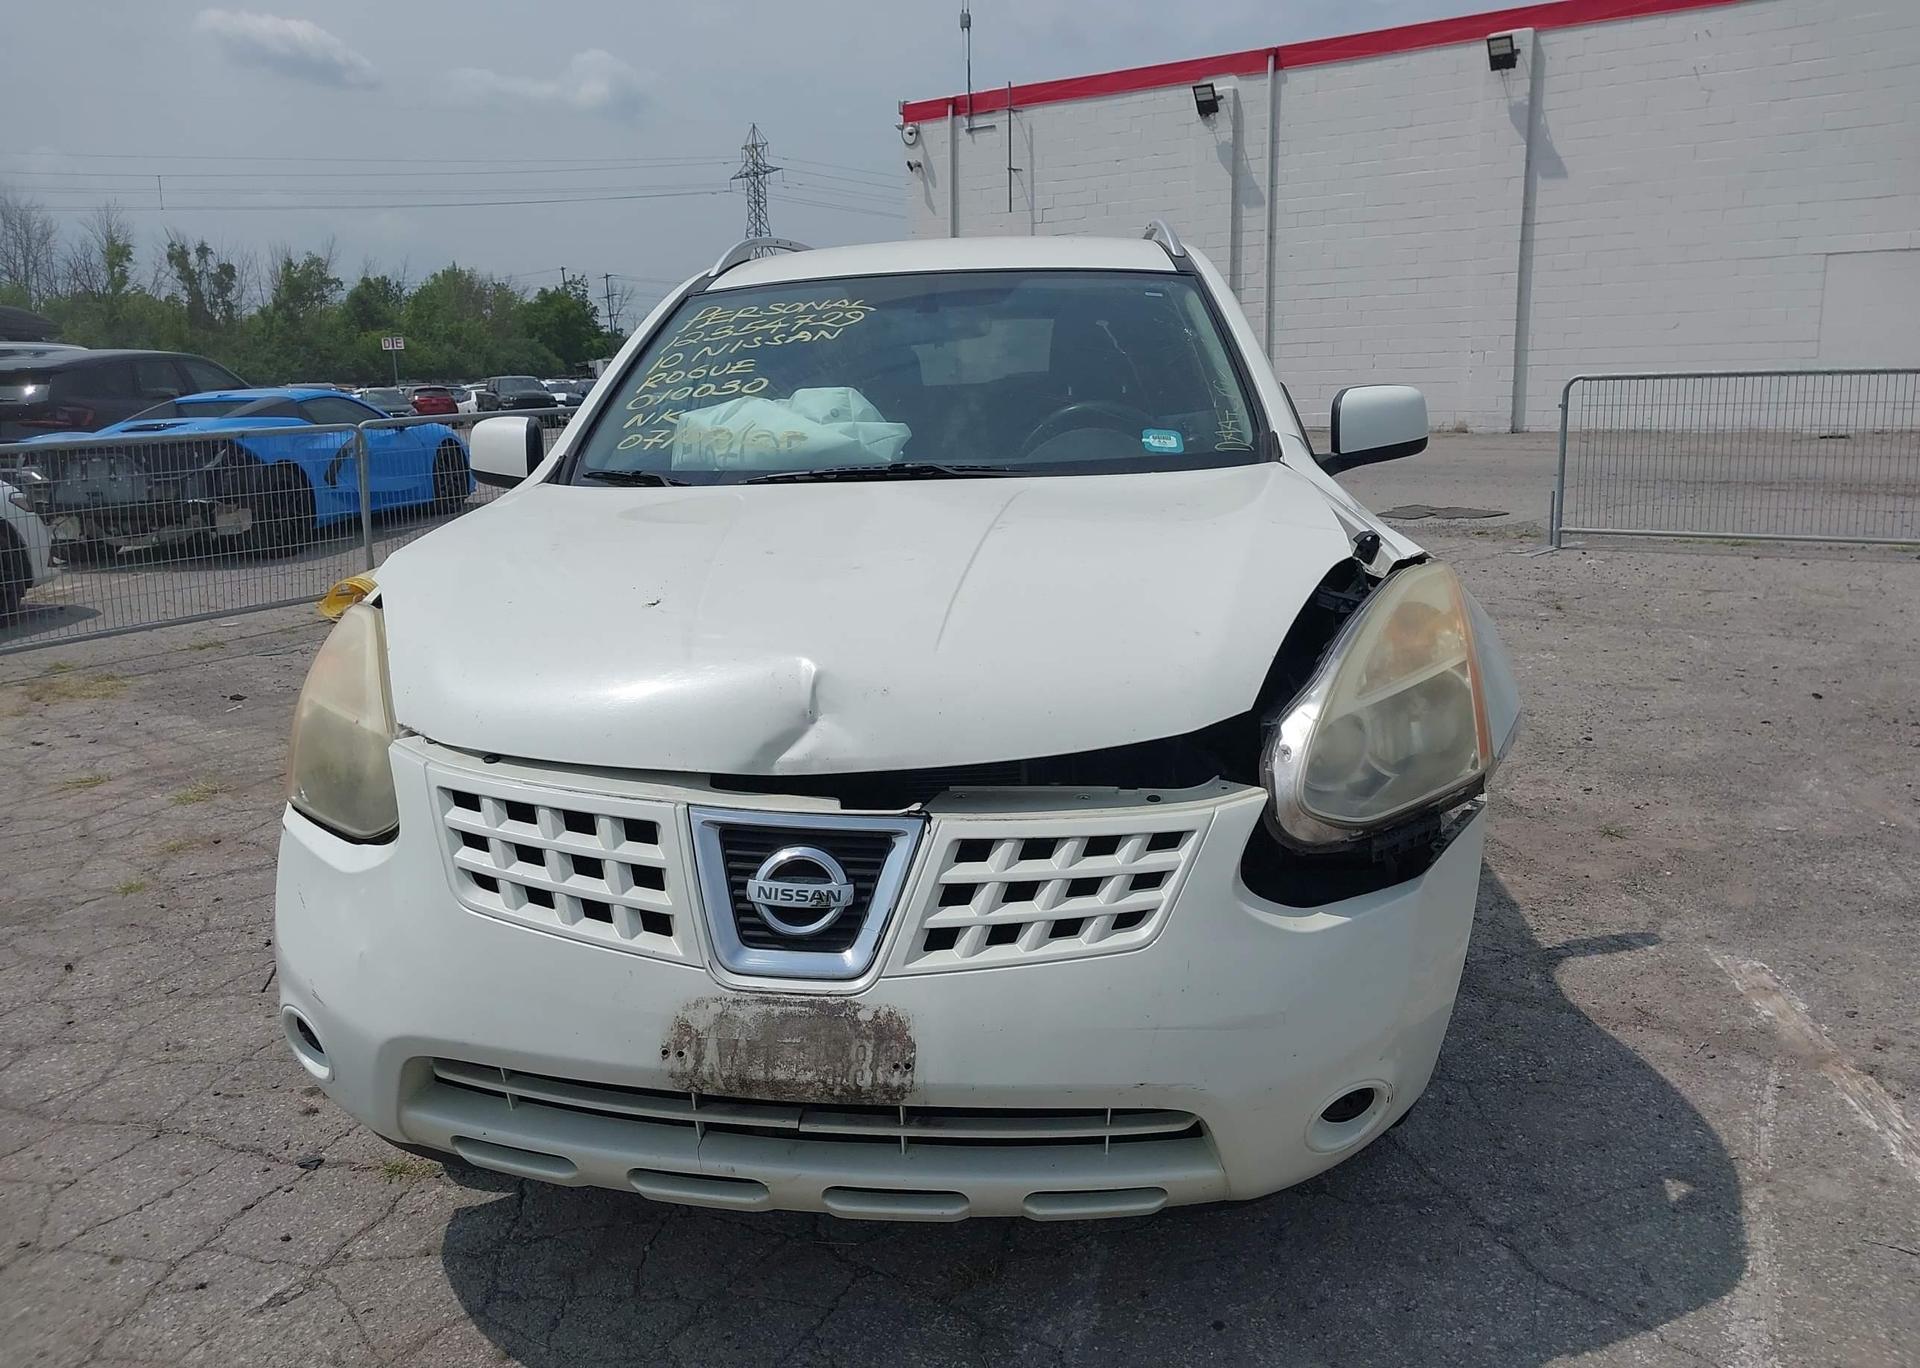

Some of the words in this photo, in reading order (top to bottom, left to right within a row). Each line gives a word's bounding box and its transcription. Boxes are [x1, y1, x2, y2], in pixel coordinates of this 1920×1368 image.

[659, 310, 865, 355] 12354729
[677, 298, 877, 333] PERSONAL
[646, 352, 684, 376] 10
[691, 327, 843, 362] NISSAN
[636, 358, 756, 394] ROGUE
[756, 885, 842, 904] NISSAN
